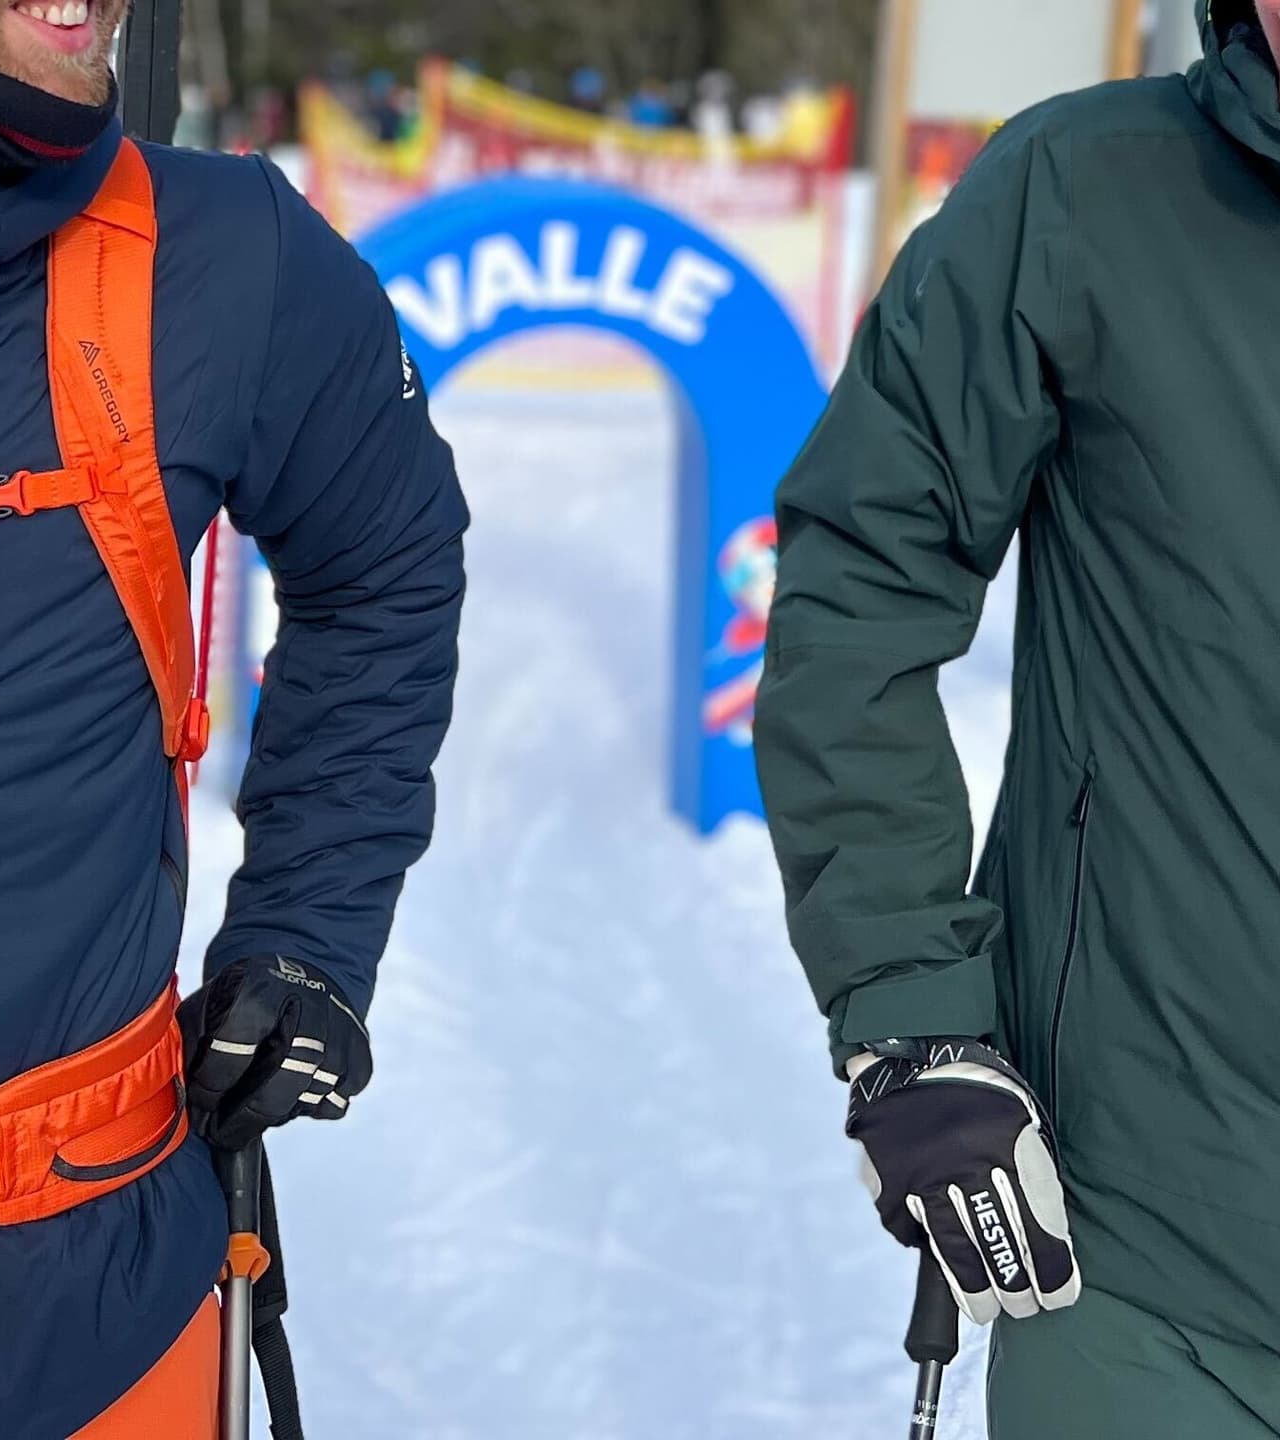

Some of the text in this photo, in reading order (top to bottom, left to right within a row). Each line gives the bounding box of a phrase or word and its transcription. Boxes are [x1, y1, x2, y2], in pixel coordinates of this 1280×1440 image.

[384, 218, 733, 350] VALLE
[91, 367, 131, 444] GREGORY
[970, 1190, 1020, 1285] HESTRA
